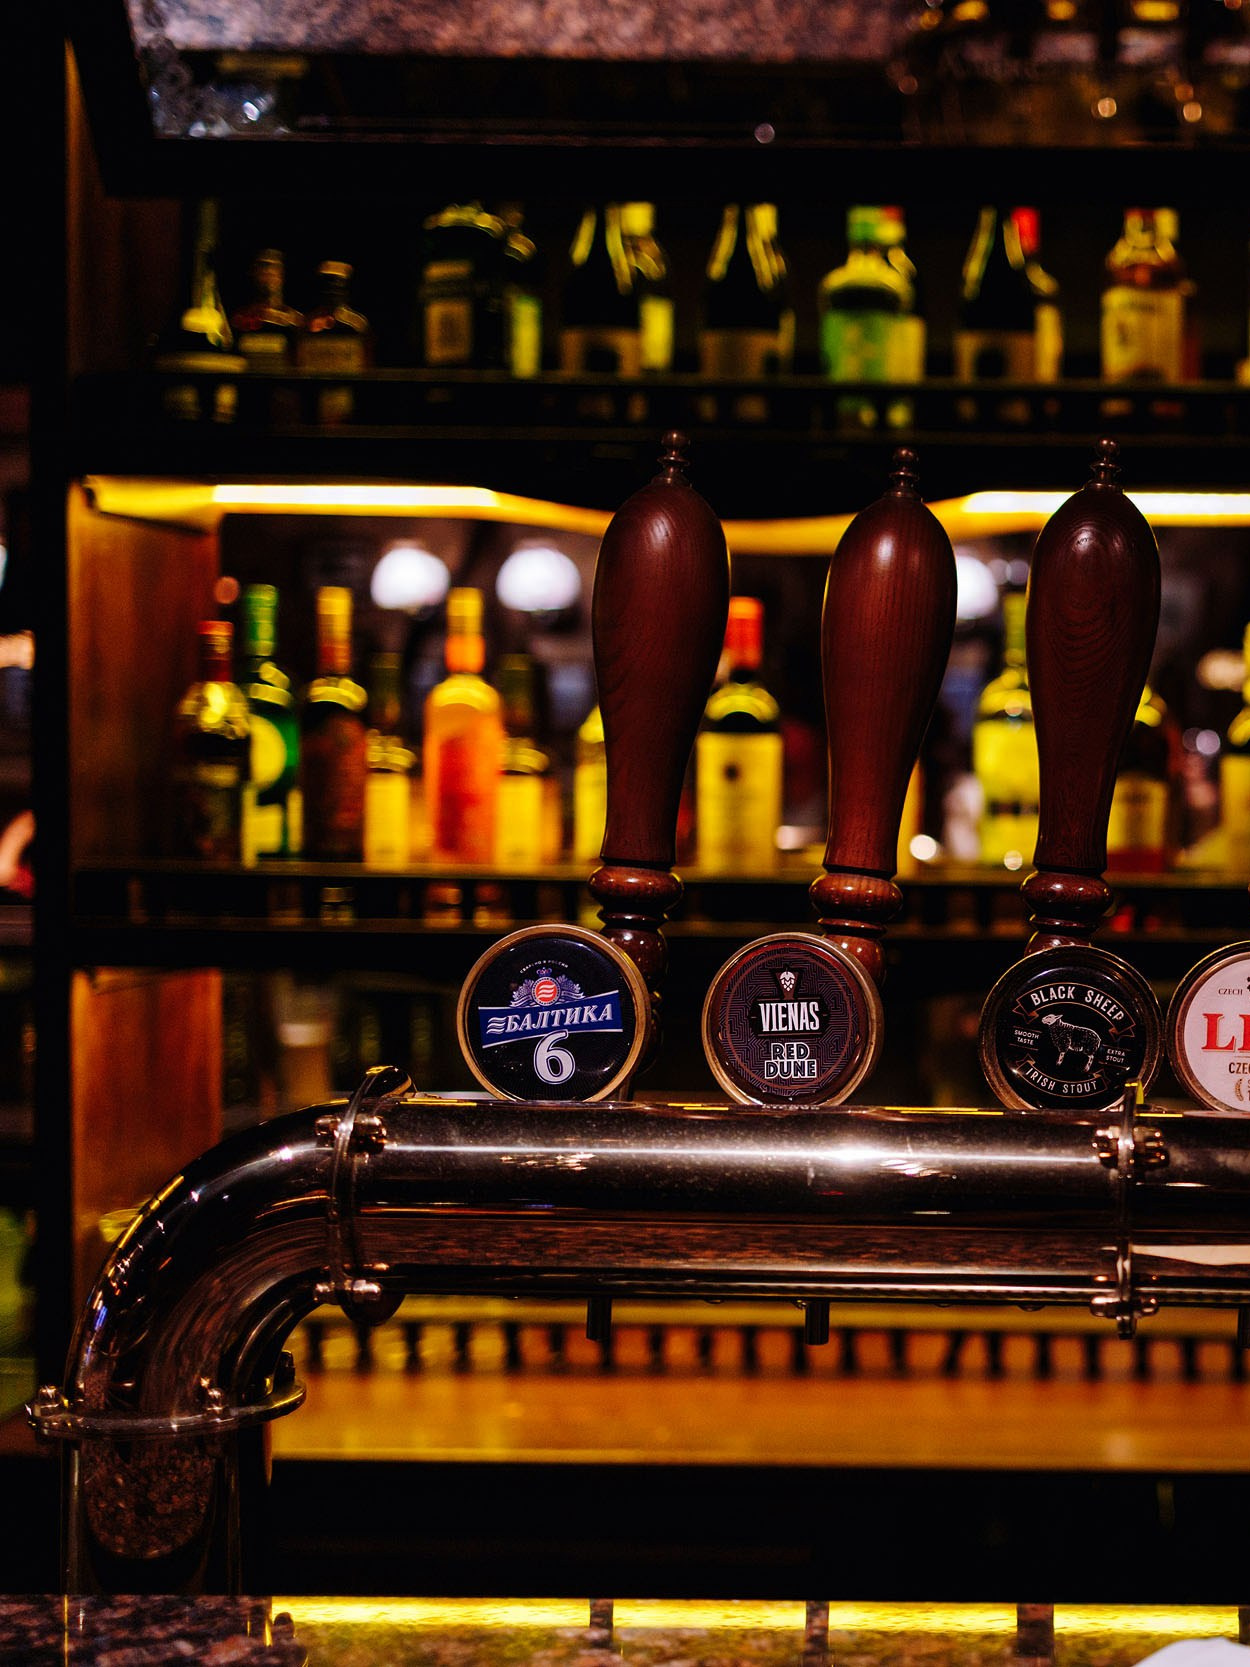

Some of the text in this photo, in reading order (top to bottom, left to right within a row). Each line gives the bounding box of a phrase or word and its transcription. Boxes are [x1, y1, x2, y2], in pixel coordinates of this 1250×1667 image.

[1218, 988, 1243, 996] CZECH
[1030, 986, 1125, 1022] BLACK SHEEP
[506, 1003, 613, 1033] БАЛТИКА
[758, 1001, 820, 1032] VIENAS
[1014, 1029, 1039, 1040] SMOOTH
[1017, 1037, 1034, 1046] TASTE
[533, 1029, 575, 1084] 6
[770, 1042, 810, 1060] RED
[1106, 1049, 1126, 1057] EXTRA
[1106, 1055, 1125, 1063] STOUT
[764, 1059, 817, 1079] DUNE
[1025, 1067, 1097, 1094] IRISH STOUT
